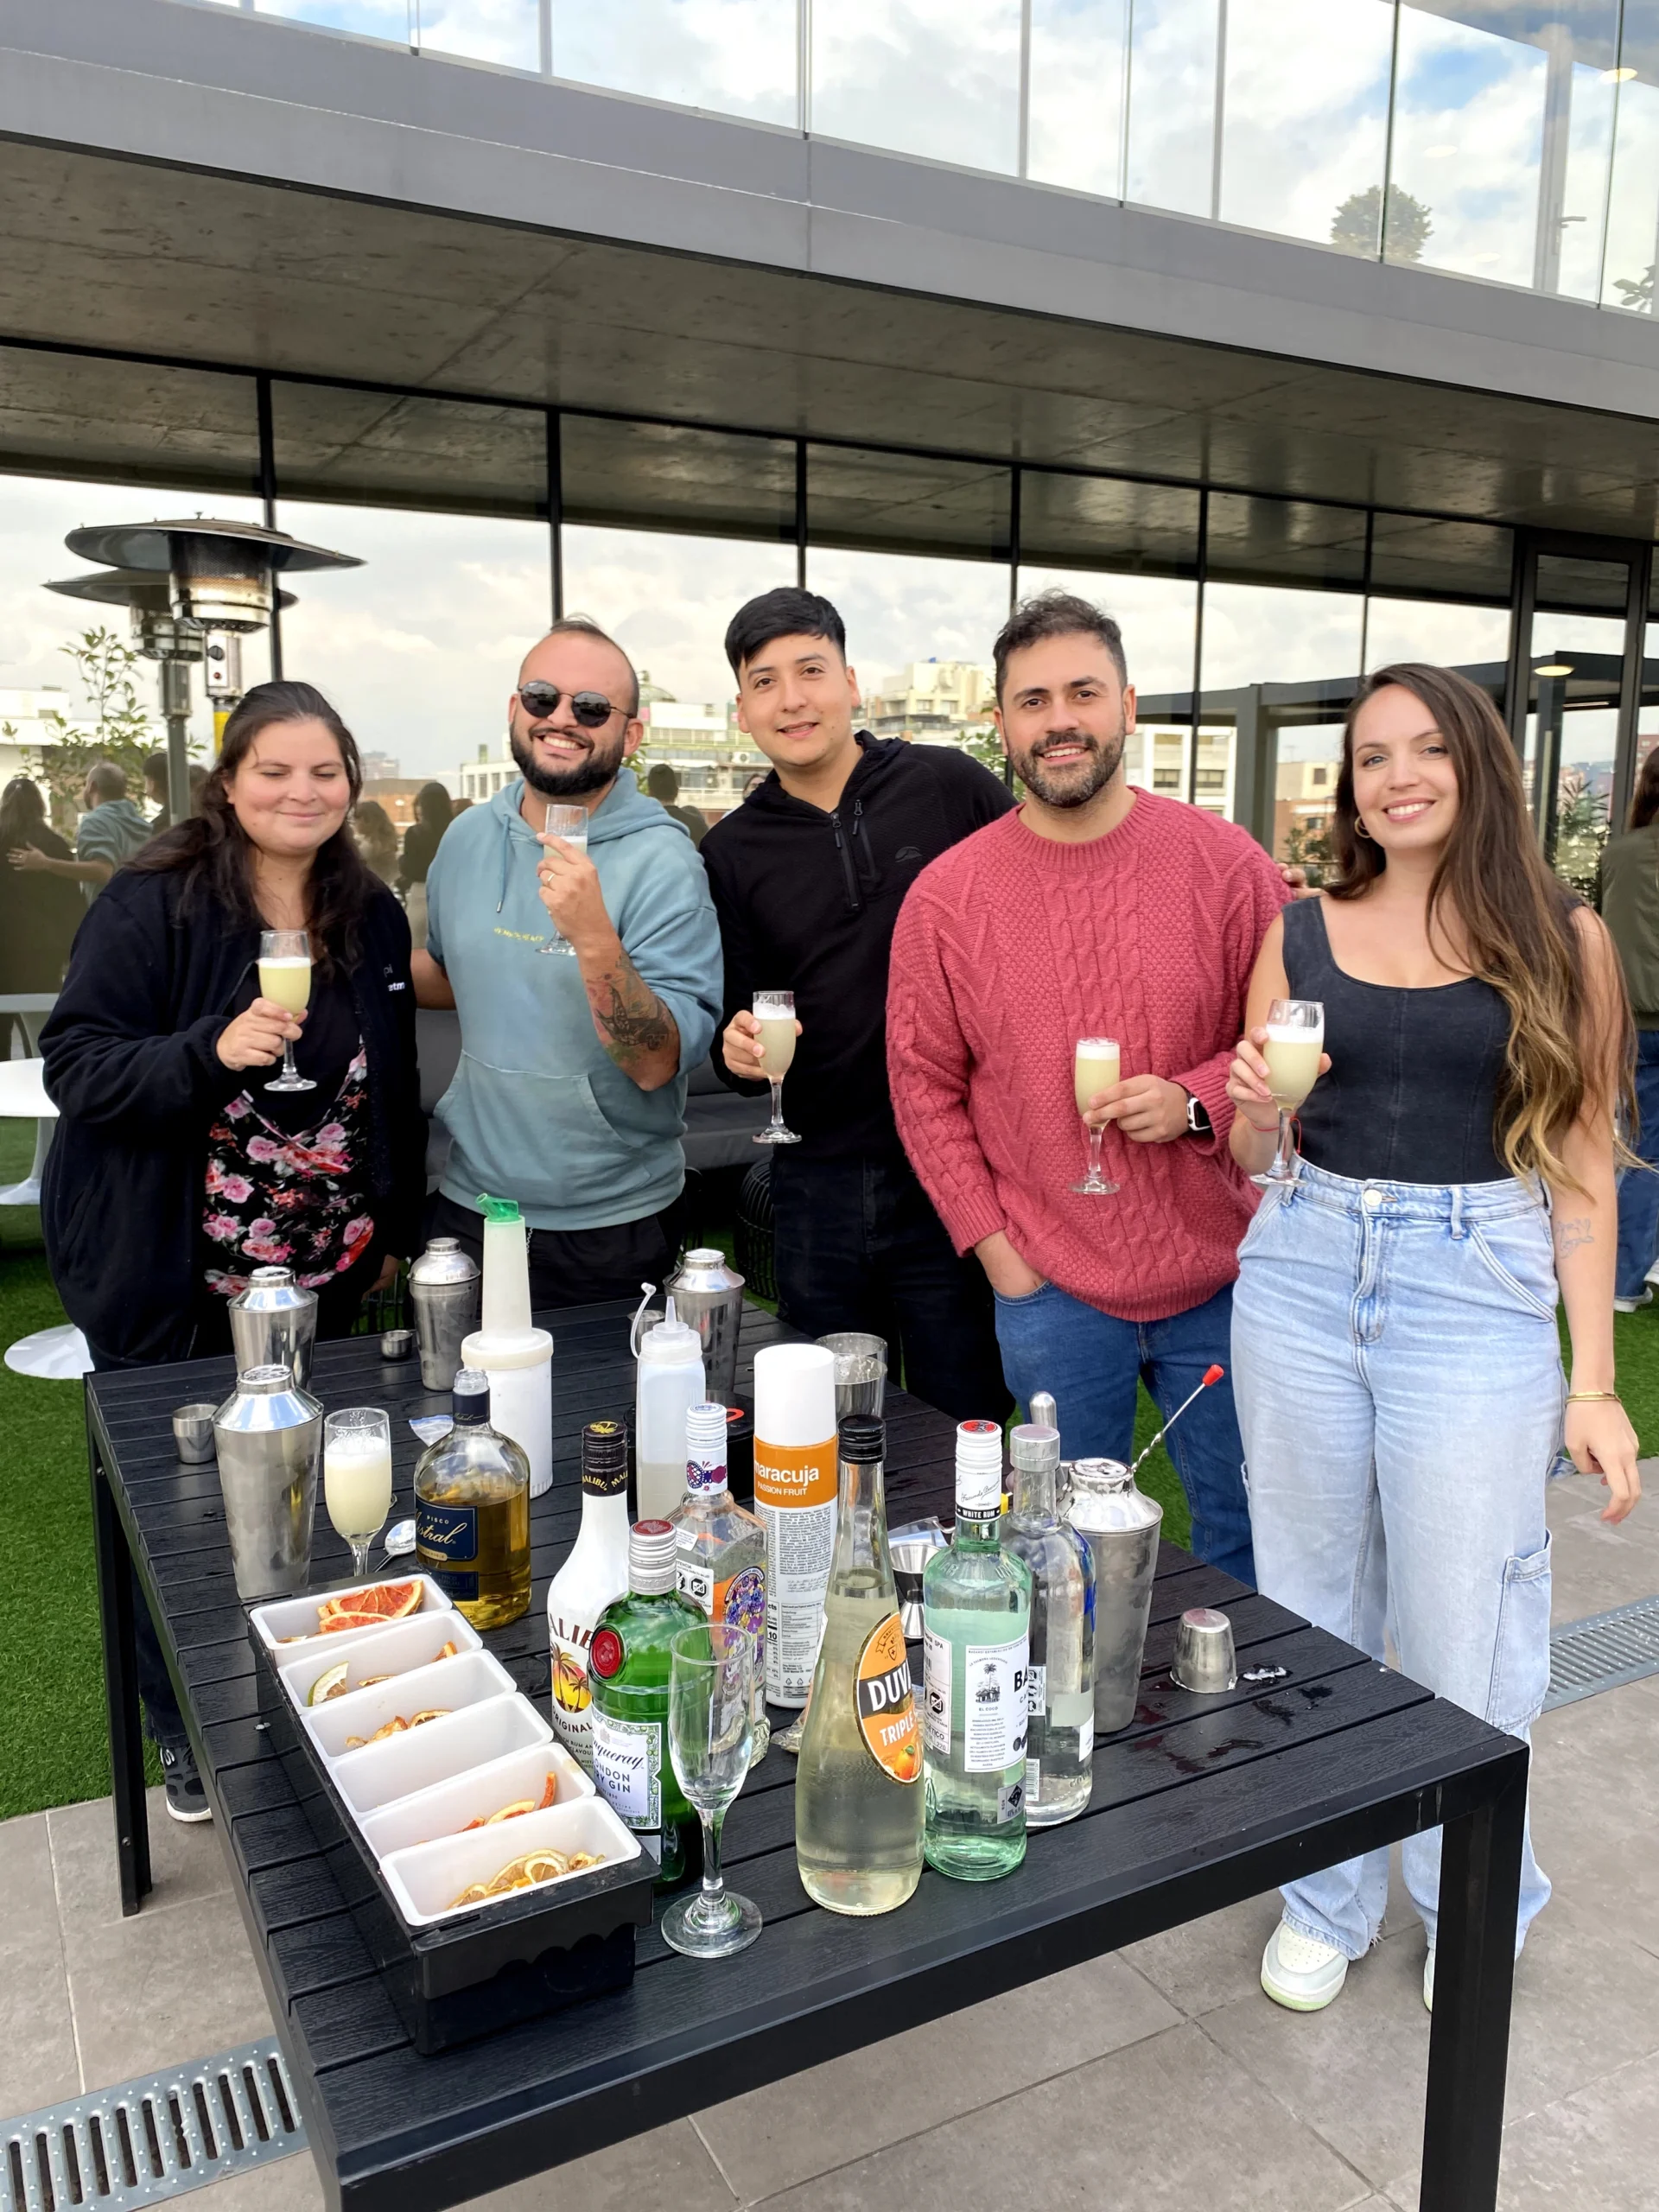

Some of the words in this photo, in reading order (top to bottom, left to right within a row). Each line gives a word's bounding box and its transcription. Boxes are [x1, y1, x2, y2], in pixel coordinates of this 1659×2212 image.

[758, 1481, 782, 1496] PASSION
[783, 1487, 807, 1497] FRUIT
[427, 1515, 449, 1525] PISCO
[962, 1509, 982, 1519] WHITE
[983, 1510, 995, 1518] RUM
[768, 1631, 778, 1640] 10
[880, 1710, 914, 1747] TRIPLE
[608, 1780, 631, 1794] GIN
